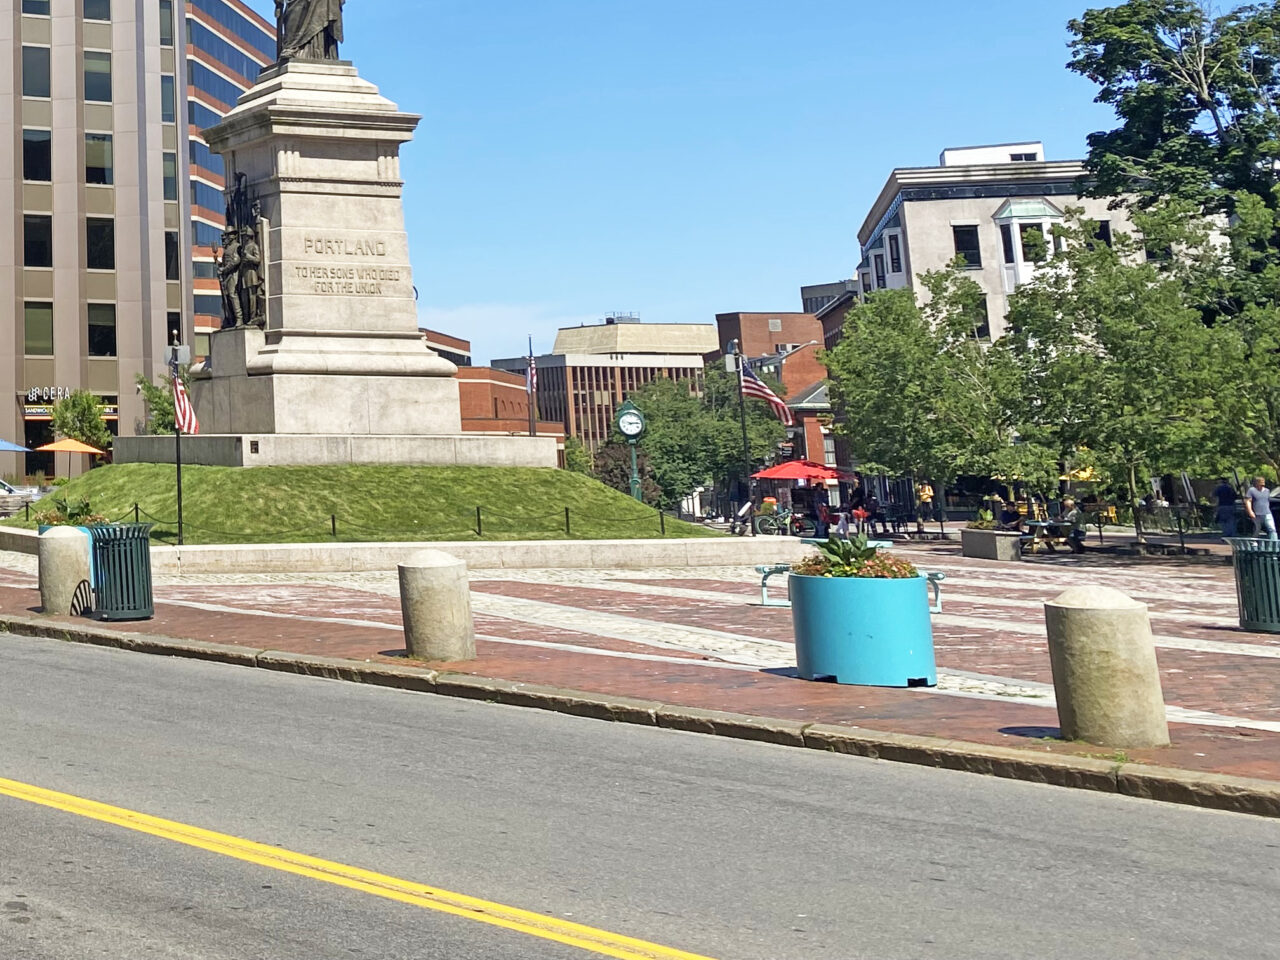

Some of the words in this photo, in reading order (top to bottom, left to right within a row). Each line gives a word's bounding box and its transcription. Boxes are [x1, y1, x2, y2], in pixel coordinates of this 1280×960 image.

[303, 237, 386, 256] PORTLAND
[295, 266, 308, 278] TO
[309, 266, 329, 279] HER
[329, 267, 355, 280] SONS
[356, 268, 377, 281] WHO
[378, 269, 400, 282] DIED
[314, 281, 334, 293] FOR
[335, 281, 354, 293] THE
[355, 282, 382, 295] UNION
[42, 386, 71, 401] CERA
